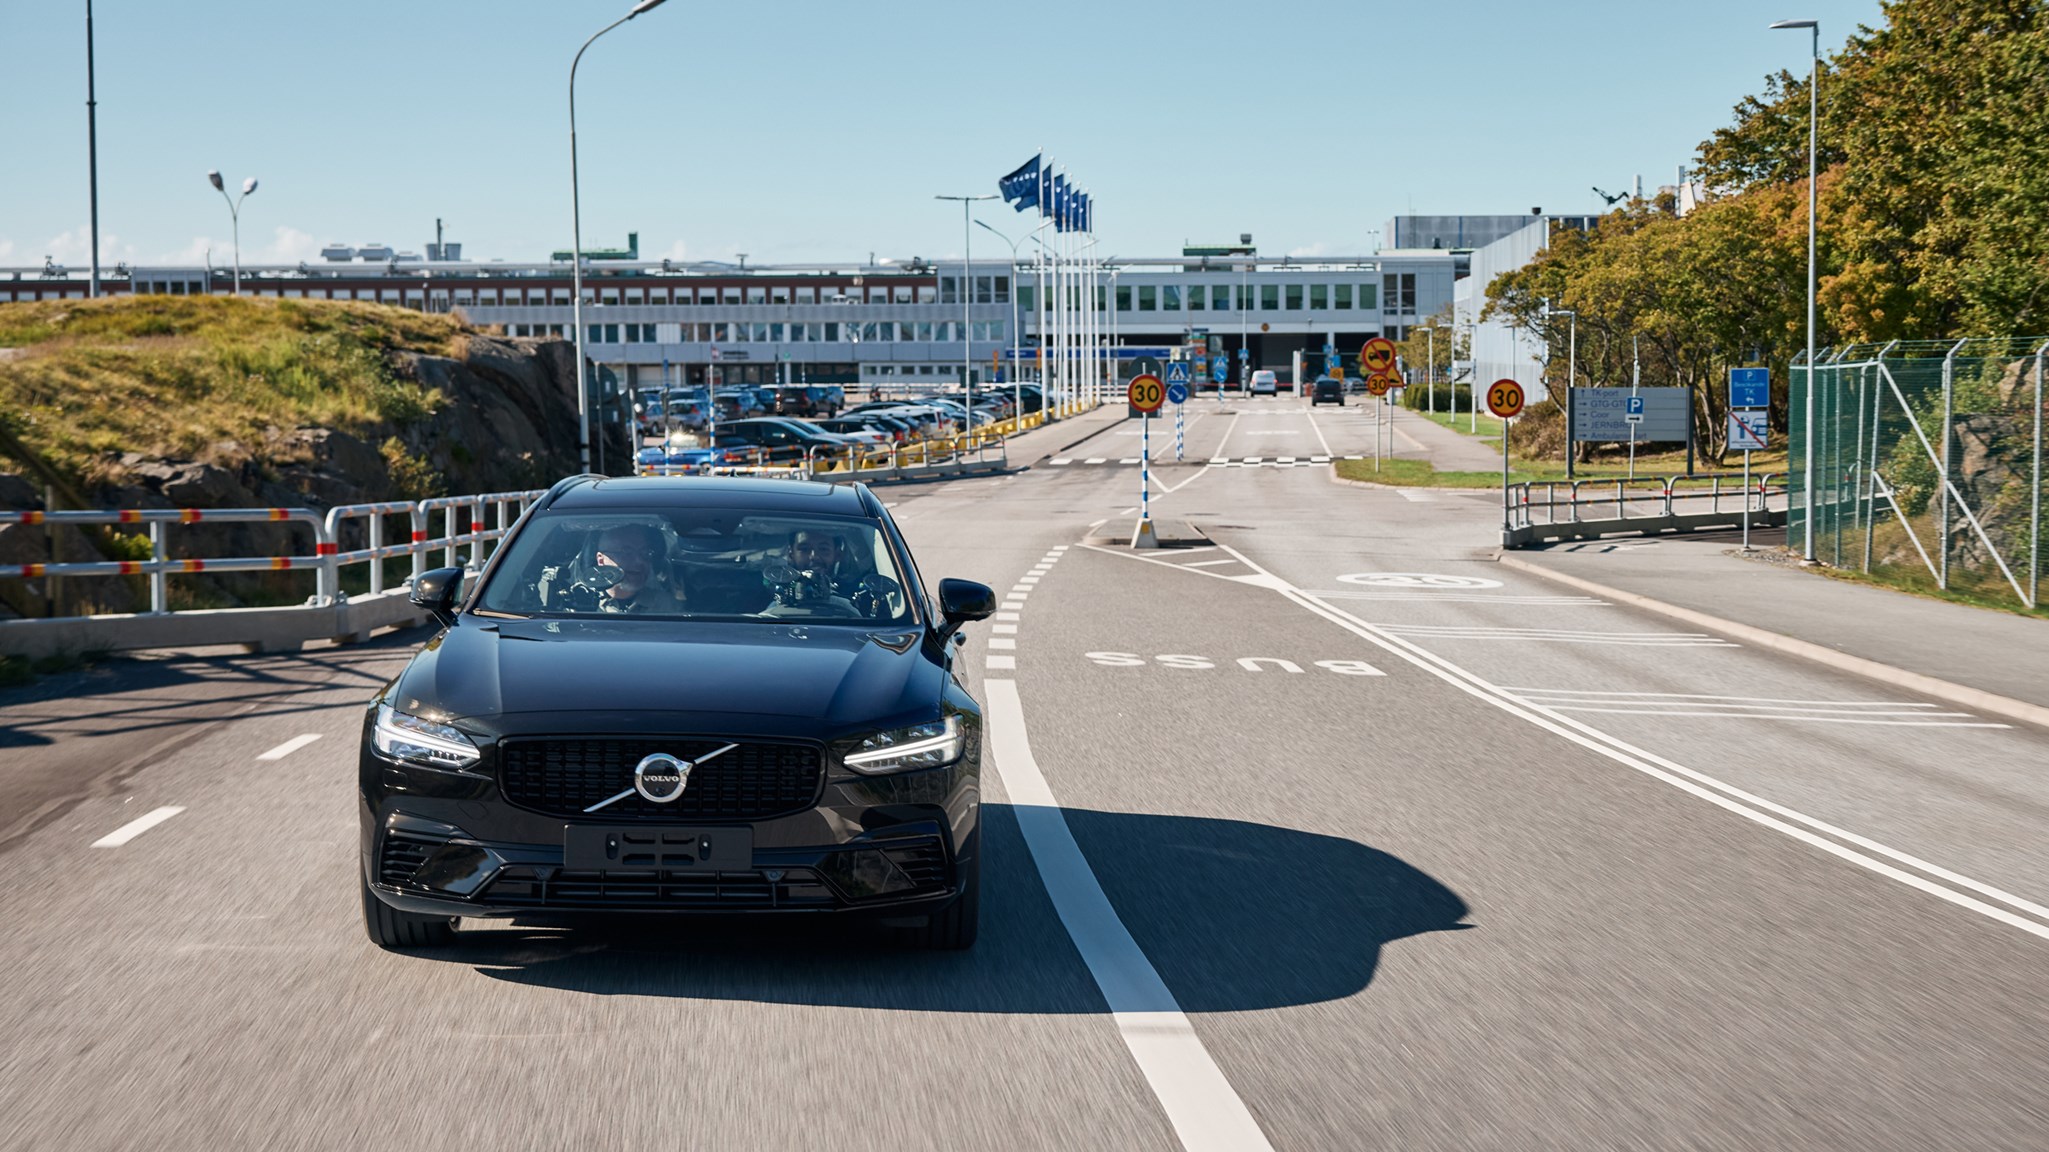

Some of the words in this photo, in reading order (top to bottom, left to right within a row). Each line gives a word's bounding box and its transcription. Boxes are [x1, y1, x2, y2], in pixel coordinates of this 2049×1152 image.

[1135, 384, 1159, 403] 30
[1372, 379, 1386, 390] 30
[1494, 389, 1519, 408] 30
[1630, 399, 1641, 413] P
[1085, 651, 1389, 676] BUSS
